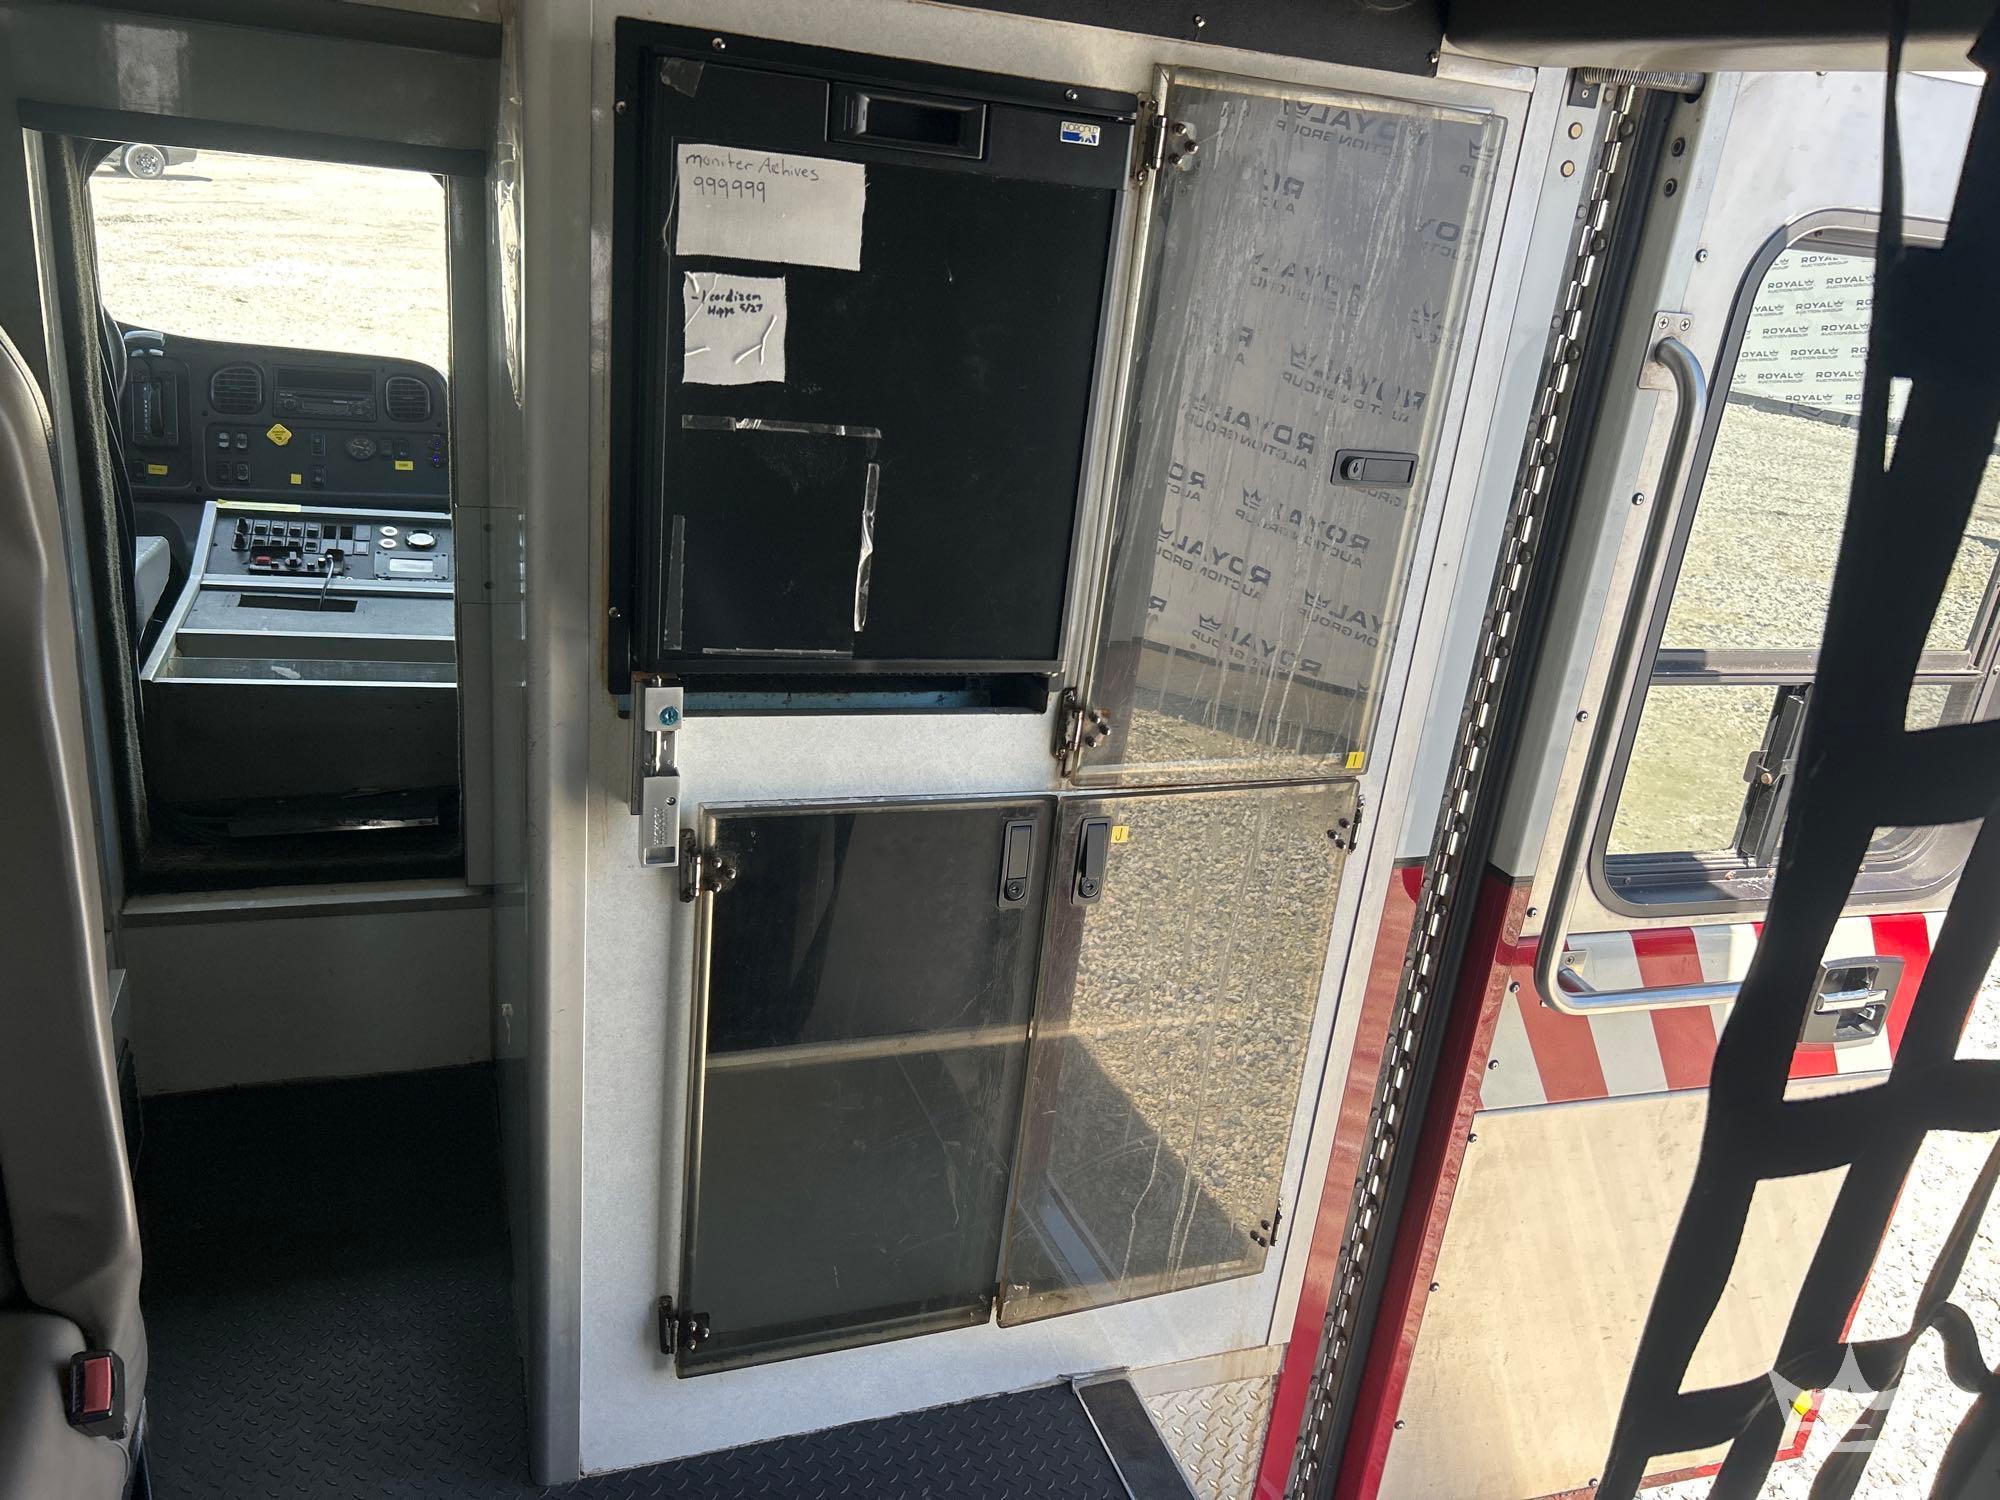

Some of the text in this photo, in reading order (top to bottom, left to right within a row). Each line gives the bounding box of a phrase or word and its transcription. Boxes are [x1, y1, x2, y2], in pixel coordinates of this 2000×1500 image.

[693, 176, 766, 204] 999999
[1826, 275, 1865, 285] ROYAL
[1767, 280, 1804, 290] ROYAL
[1754, 305, 1775, 313] YAL
[1795, 301, 1833, 310] ROYAL
[1762, 327, 1799, 335] ROYAL
[1821, 323, 1861, 332] ROYAL
[1741, 351, 1770, 359] OYAL
[1790, 348, 1828, 356] ROYAL
[1757, 372, 1794, 380] ROYAL
[1816, 371, 1854, 379] ROYAL
[1785, 394, 1823, 402] ROYAL
